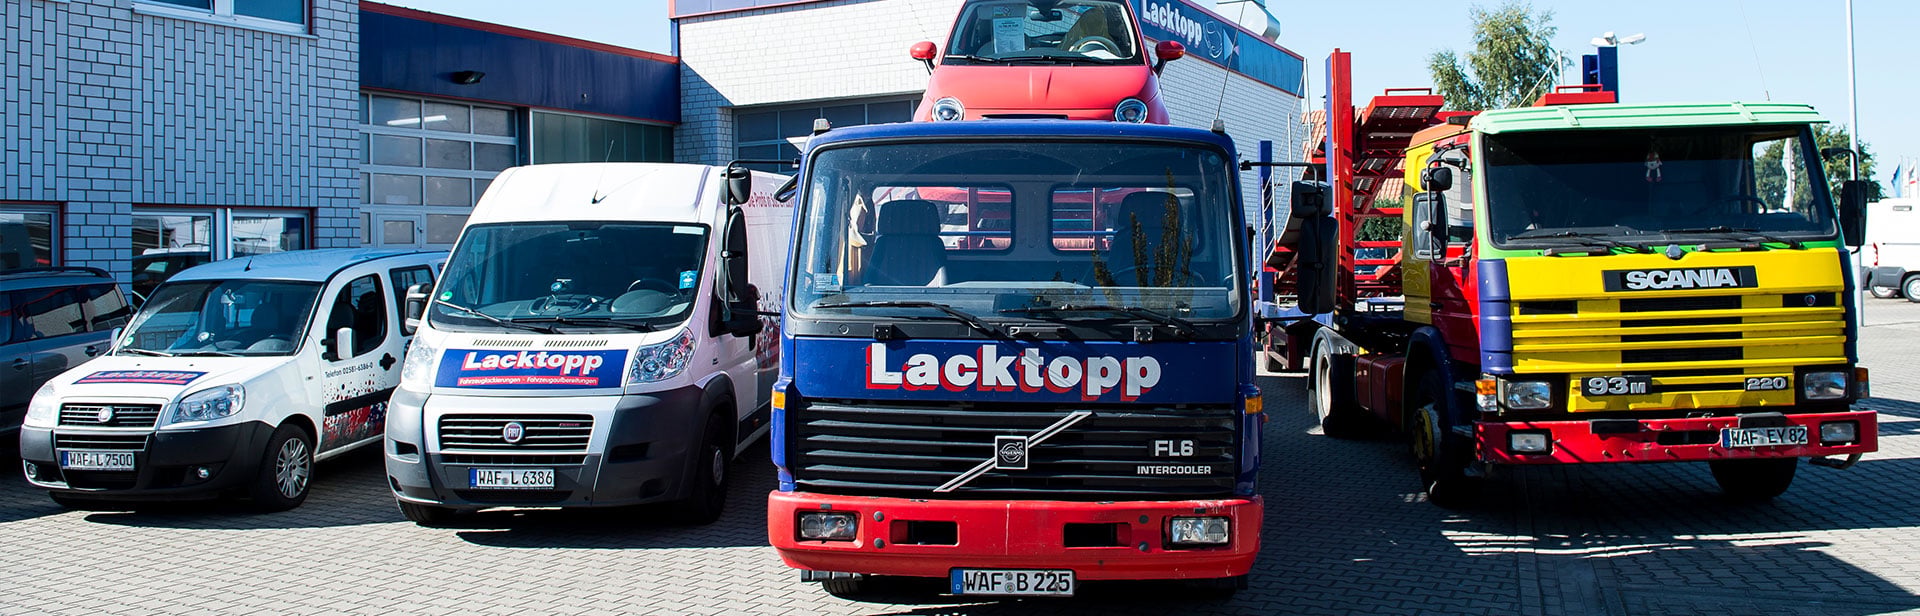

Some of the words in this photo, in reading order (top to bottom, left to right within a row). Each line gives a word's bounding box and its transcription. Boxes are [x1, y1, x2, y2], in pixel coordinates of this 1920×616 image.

[1142, 0, 1202, 47] Lacktopp
[1626, 268, 1738, 290] SCANIA
[462, 351, 603, 375] Lacktopp
[87, 371, 199, 380] Lacktopp
[325, 370, 342, 378] Telefon
[866, 343, 1162, 400] Lacktopp
[460, 376, 521, 385] Fahrzeuglackierungen
[526, 376, 597, 385] Fahrzeugaufbereitungen
[1746, 377, 1787, 391] 220
[508, 427, 520, 438] FIAT
[1731, 430, 1758, 445] WAF
[1767, 429, 1785, 443] EY
[1789, 428, 1807, 443] 82
[1155, 440, 1194, 457] FL6
[70, 453, 89, 466] WAF
[96, 453, 104, 466] L
[105, 453, 133, 466] 7500
[479, 470, 501, 485] WAF
[511, 471, 518, 485] L
[522, 470, 553, 485] 6386
[1137, 465, 1212, 475] INTERCOOLER
[965, 572, 1004, 591] WAF
[1016, 572, 1029, 592] B
[1034, 572, 1071, 592] 225
